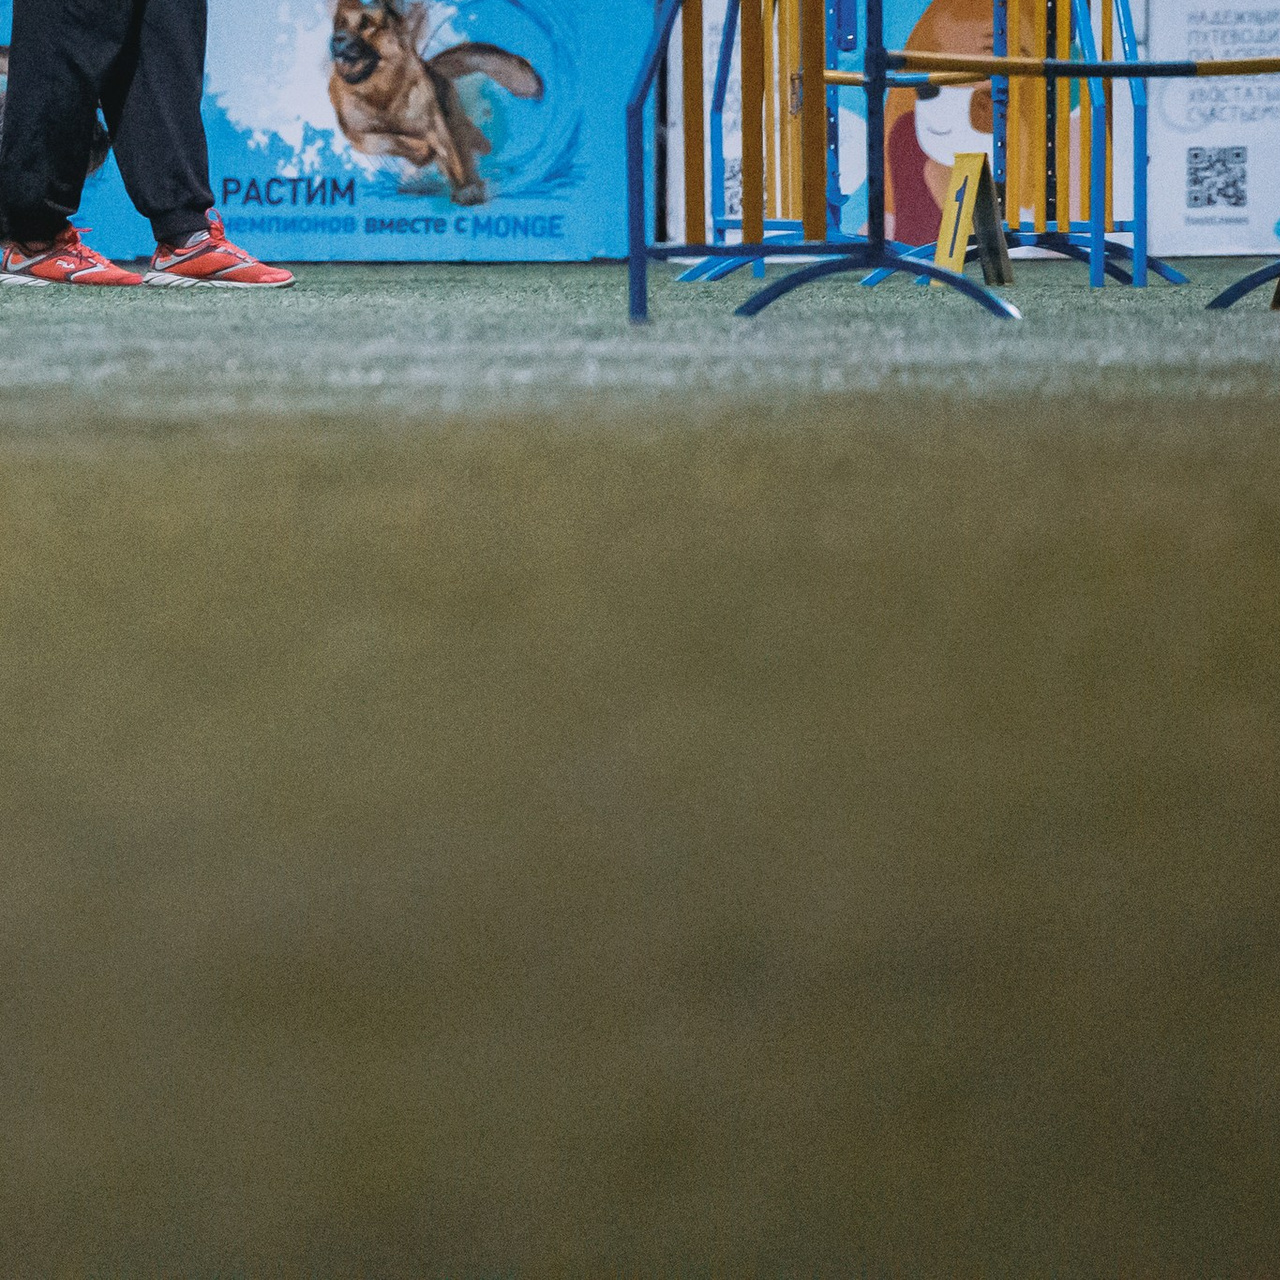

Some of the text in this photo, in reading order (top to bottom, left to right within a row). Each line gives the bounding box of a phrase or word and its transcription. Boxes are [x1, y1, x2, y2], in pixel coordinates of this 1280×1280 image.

[221, 177, 355, 206] РАСТИМ
[365, 216, 448, 234] вместе
[472, 216, 565, 239] MONGE
[948, 175, 968, 258] 1
